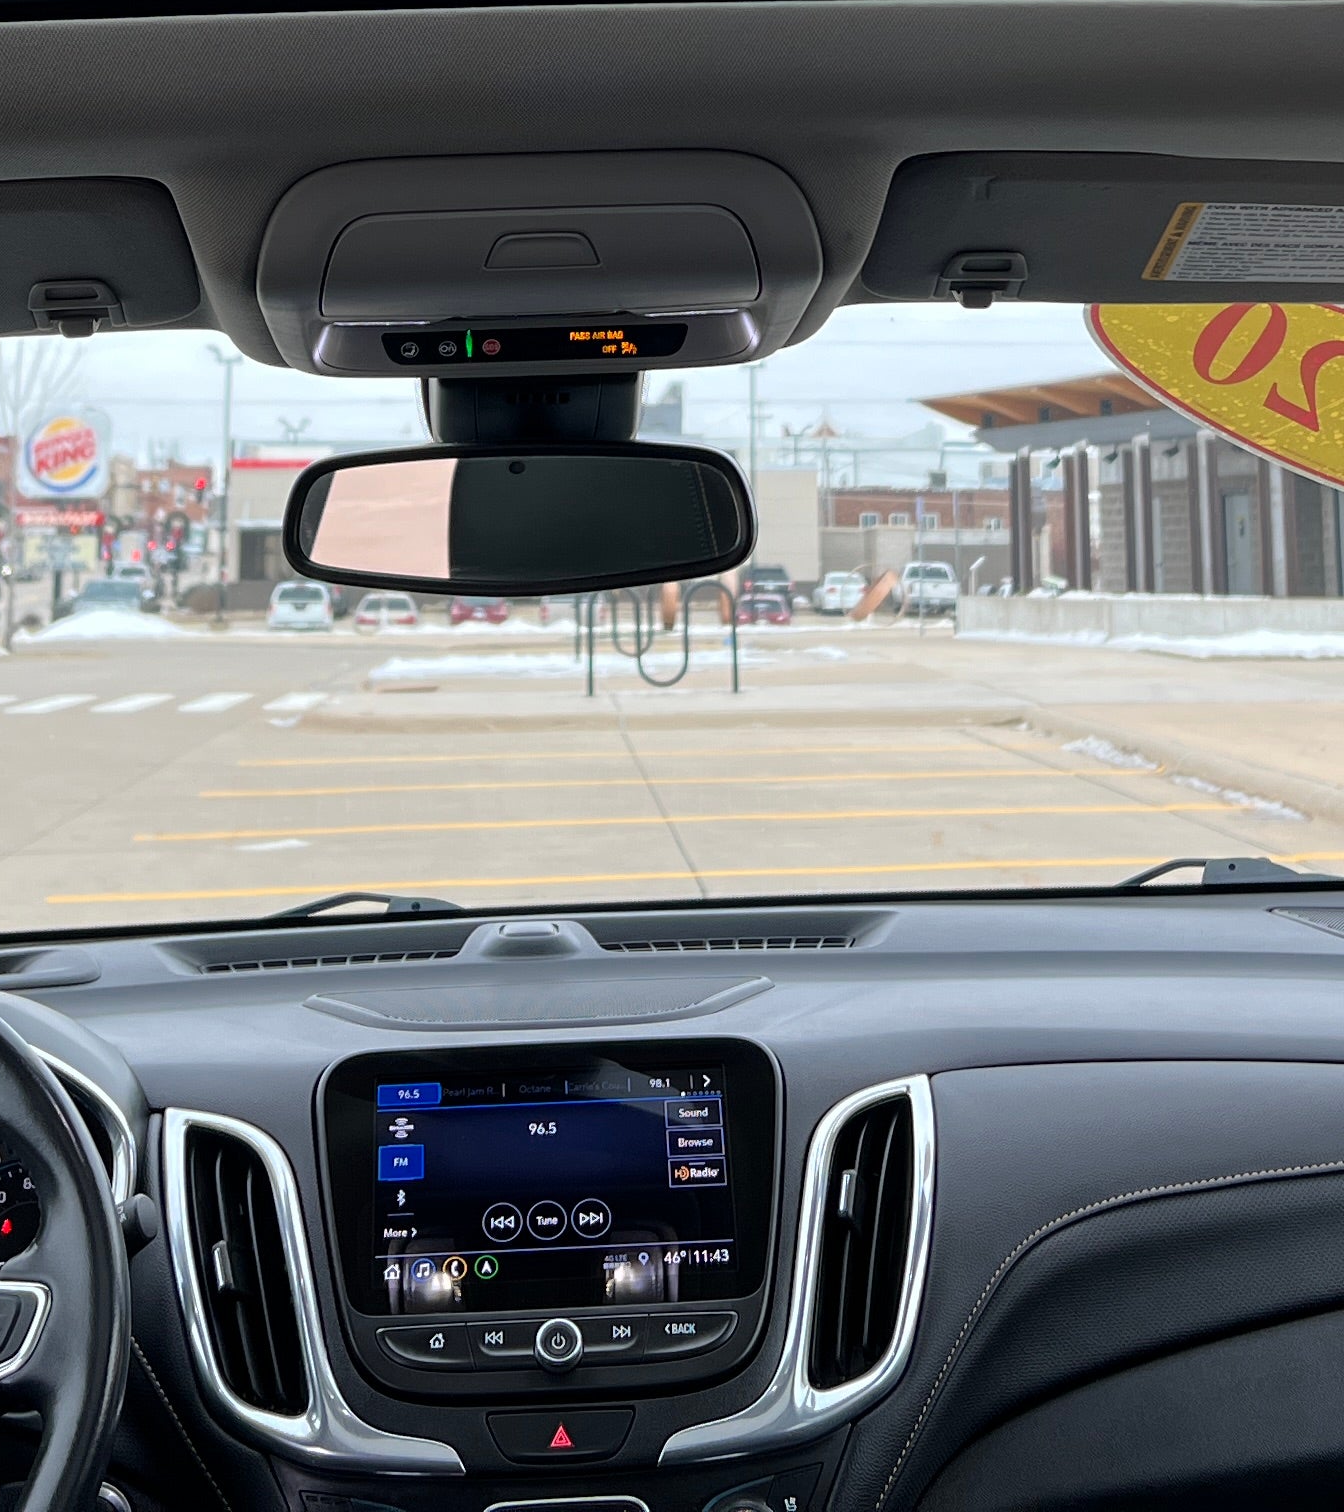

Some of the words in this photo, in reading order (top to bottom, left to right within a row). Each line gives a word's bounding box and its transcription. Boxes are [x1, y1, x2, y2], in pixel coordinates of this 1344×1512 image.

[569, 331, 591, 341] PASS
[592, 331, 606, 340] AIR
[607, 329, 624, 340] BAG
[602, 344, 618, 354] OFF
[36, 442, 96, 475] KING
[649, 1078, 670, 1088] 98.1
[397, 1088, 420, 1099] 96.5
[442, 1087, 466, 1097] Pearl
[467, 1087, 486, 1098] Jam
[518, 1084, 552, 1094] Octane
[678, 1107, 709, 1118] Sound
[528, 1121, 557, 1136] 96.5
[677, 1137, 714, 1148] Browse
[393, 1157, 409, 1168] FM
[690, 1166, 718, 1178] Radio
[535, 1215, 559, 1226] Tune
[383, 1228, 408, 1238] More
[693, 1248, 730, 1264] 11:43
[671, 1323, 697, 1335] BACK
